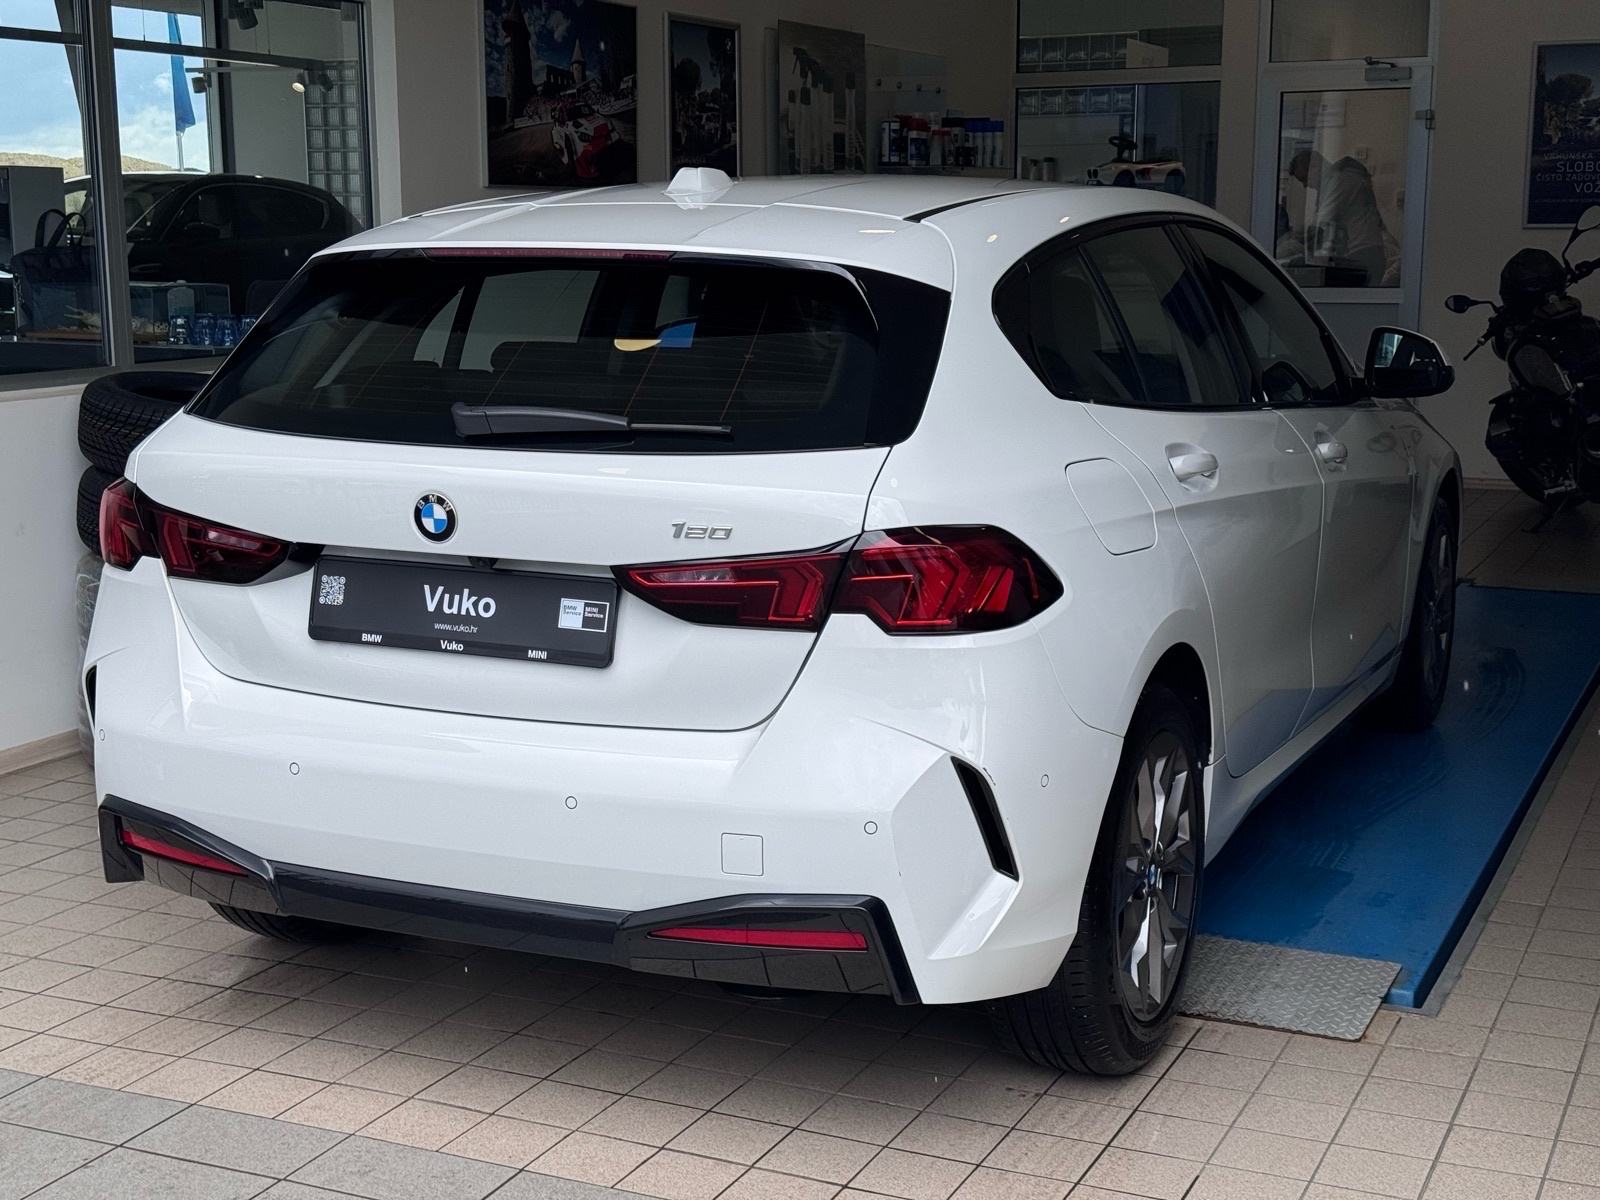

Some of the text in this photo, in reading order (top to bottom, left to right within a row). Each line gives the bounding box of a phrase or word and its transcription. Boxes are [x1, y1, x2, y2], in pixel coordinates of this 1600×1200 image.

[417, 494, 453, 512] BMW
[671, 521, 733, 540] 120
[423, 584, 497, 618] Vuko
[434, 623, 478, 633] www.vuko.hr
[361, 633, 383, 643] BMW
[440, 640, 464, 651] Vuko
[527, 649, 548, 660] MINI
